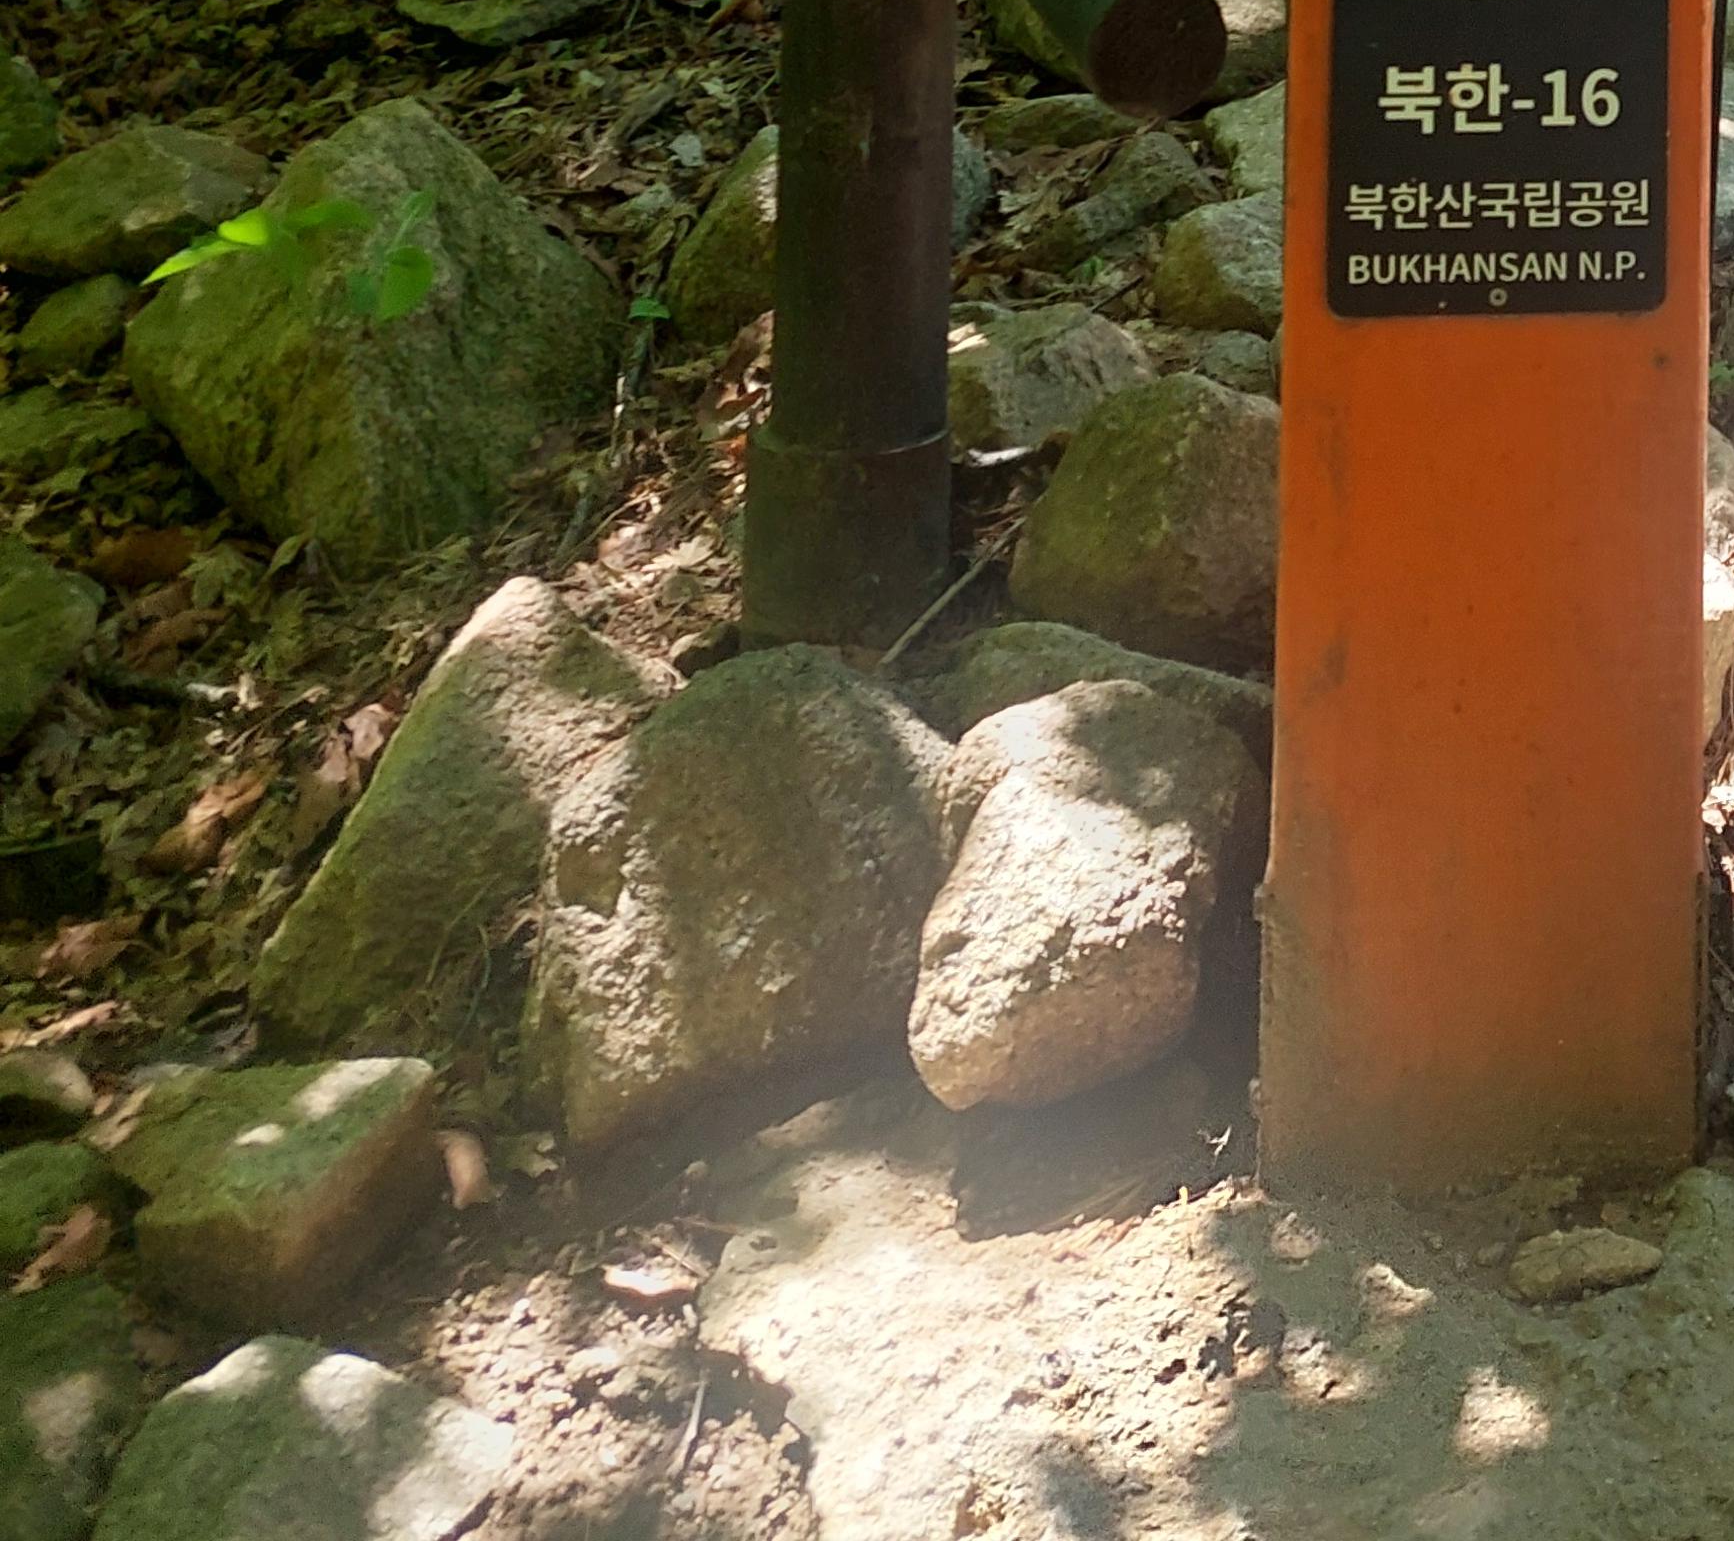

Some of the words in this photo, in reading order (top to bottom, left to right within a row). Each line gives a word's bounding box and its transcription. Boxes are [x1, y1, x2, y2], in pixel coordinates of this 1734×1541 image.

[1377, 62, 1621, 136] 북한-16
[1343, 178, 1651, 231] 북한산국립공원
[1347, 250, 1569, 285] BUKHANSAN
[1577, 249, 1647, 281] N.P.
